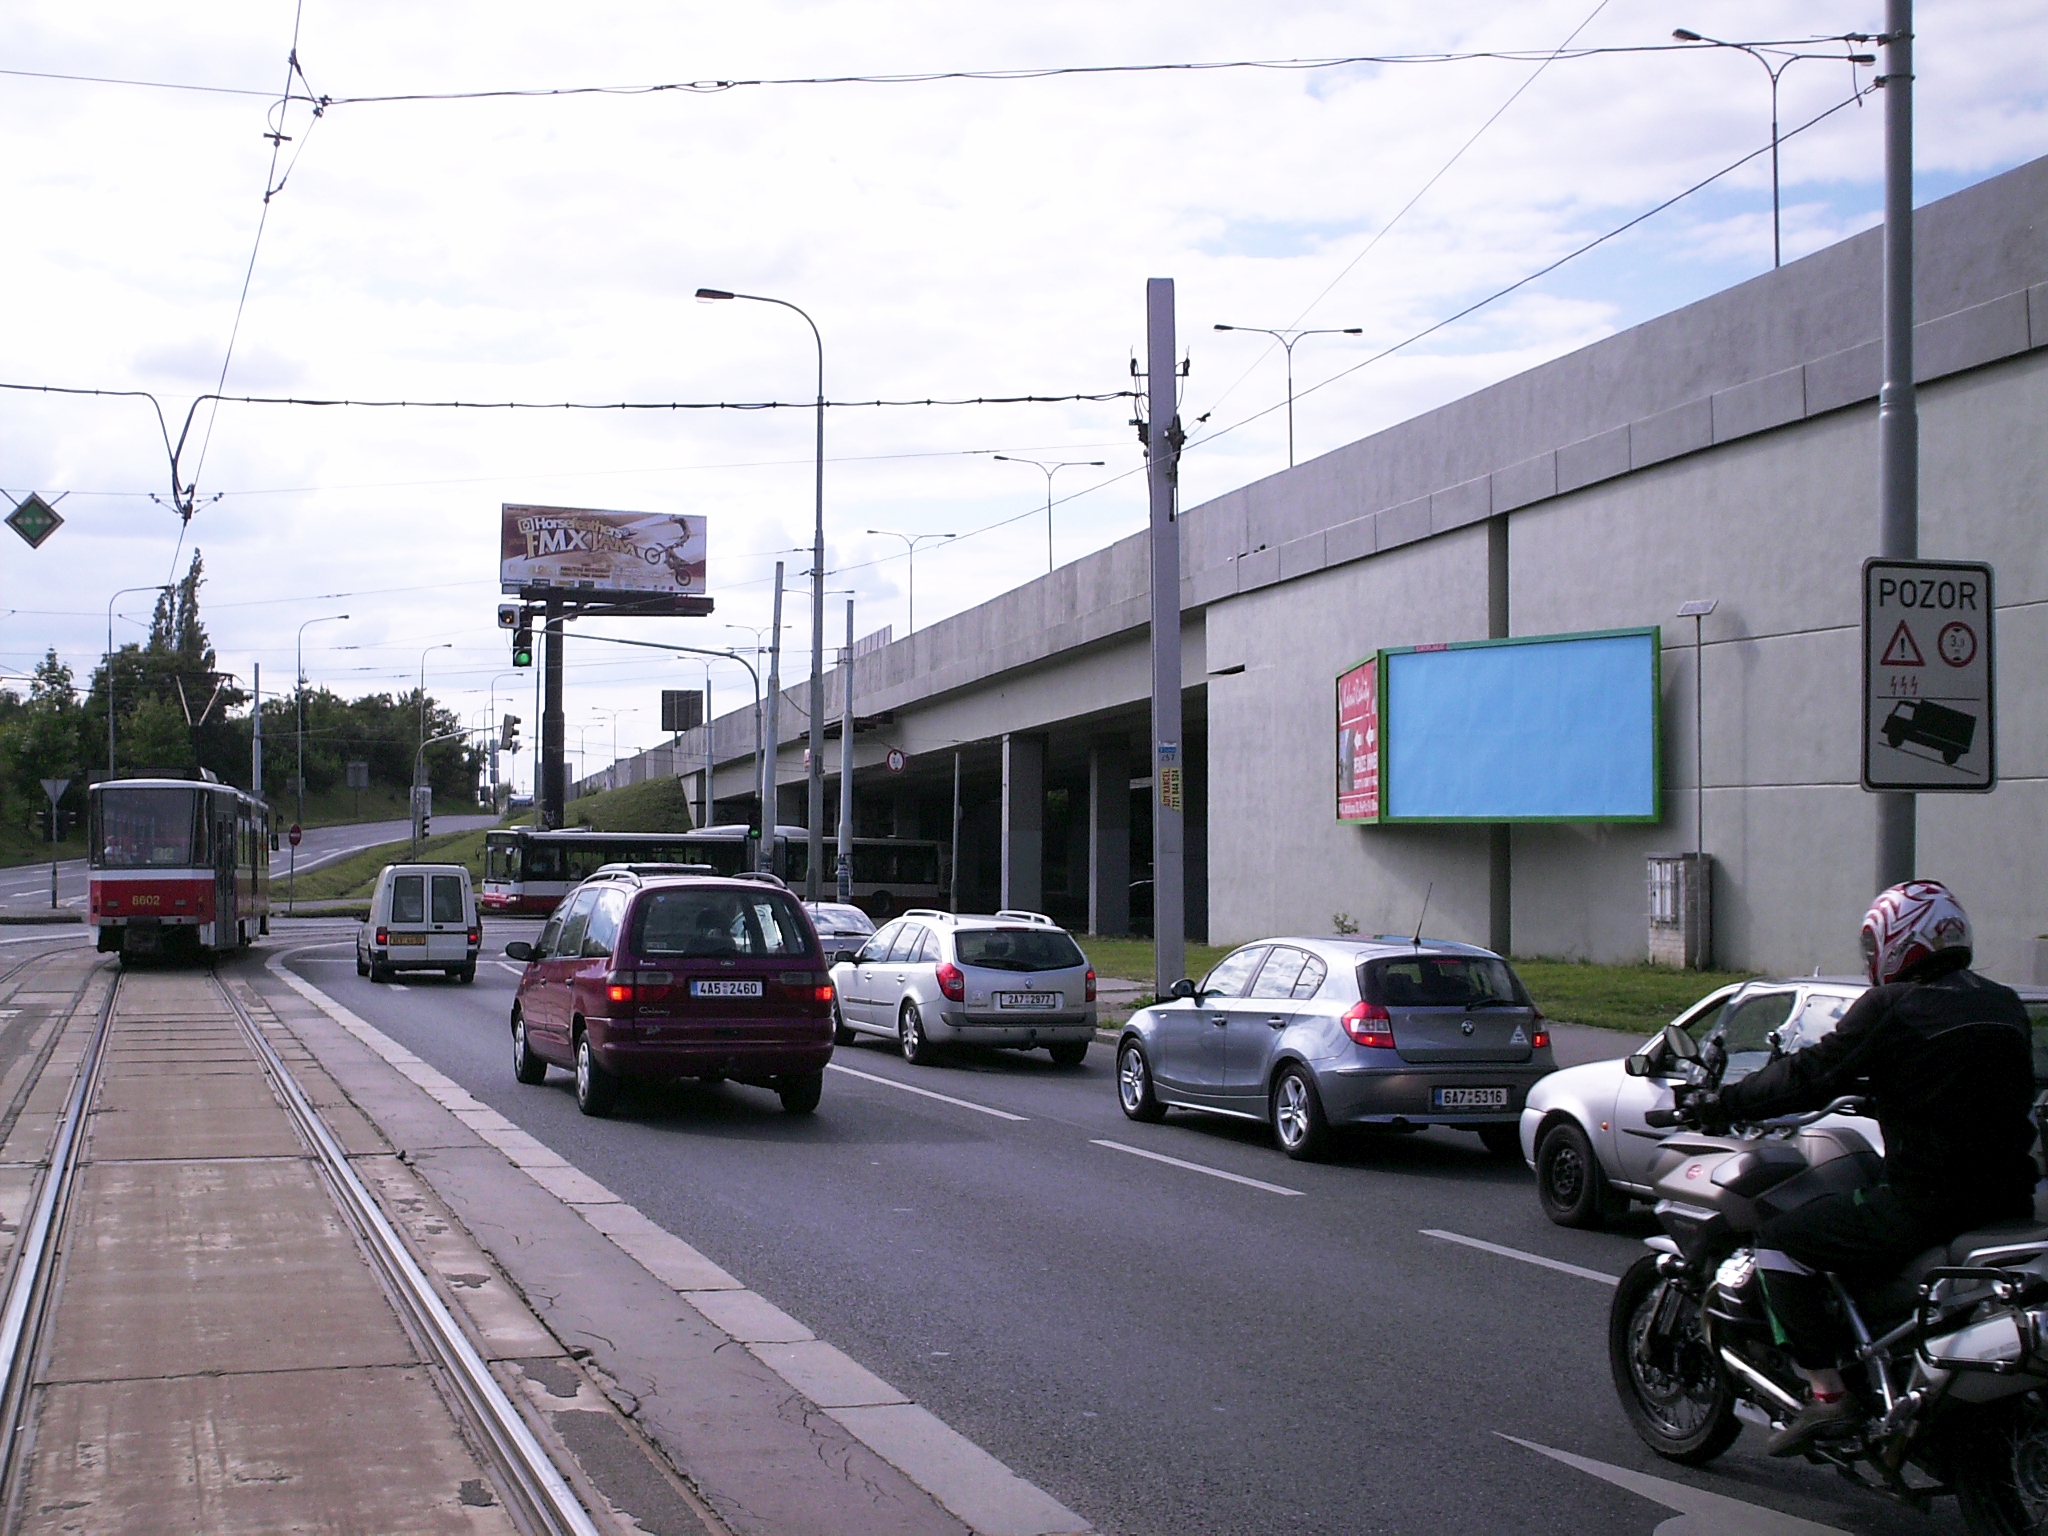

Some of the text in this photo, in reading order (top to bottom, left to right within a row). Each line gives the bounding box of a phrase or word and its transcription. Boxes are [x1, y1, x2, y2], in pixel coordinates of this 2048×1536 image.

[525, 529, 589, 559] FMX
[1879, 578, 1977, 610] POZOR
[700, 982, 758, 995] 4A5 2460
[1009, 994, 1051, 1004] 2A7 2977
[1444, 1090, 1502, 1104] 6A7 5316
